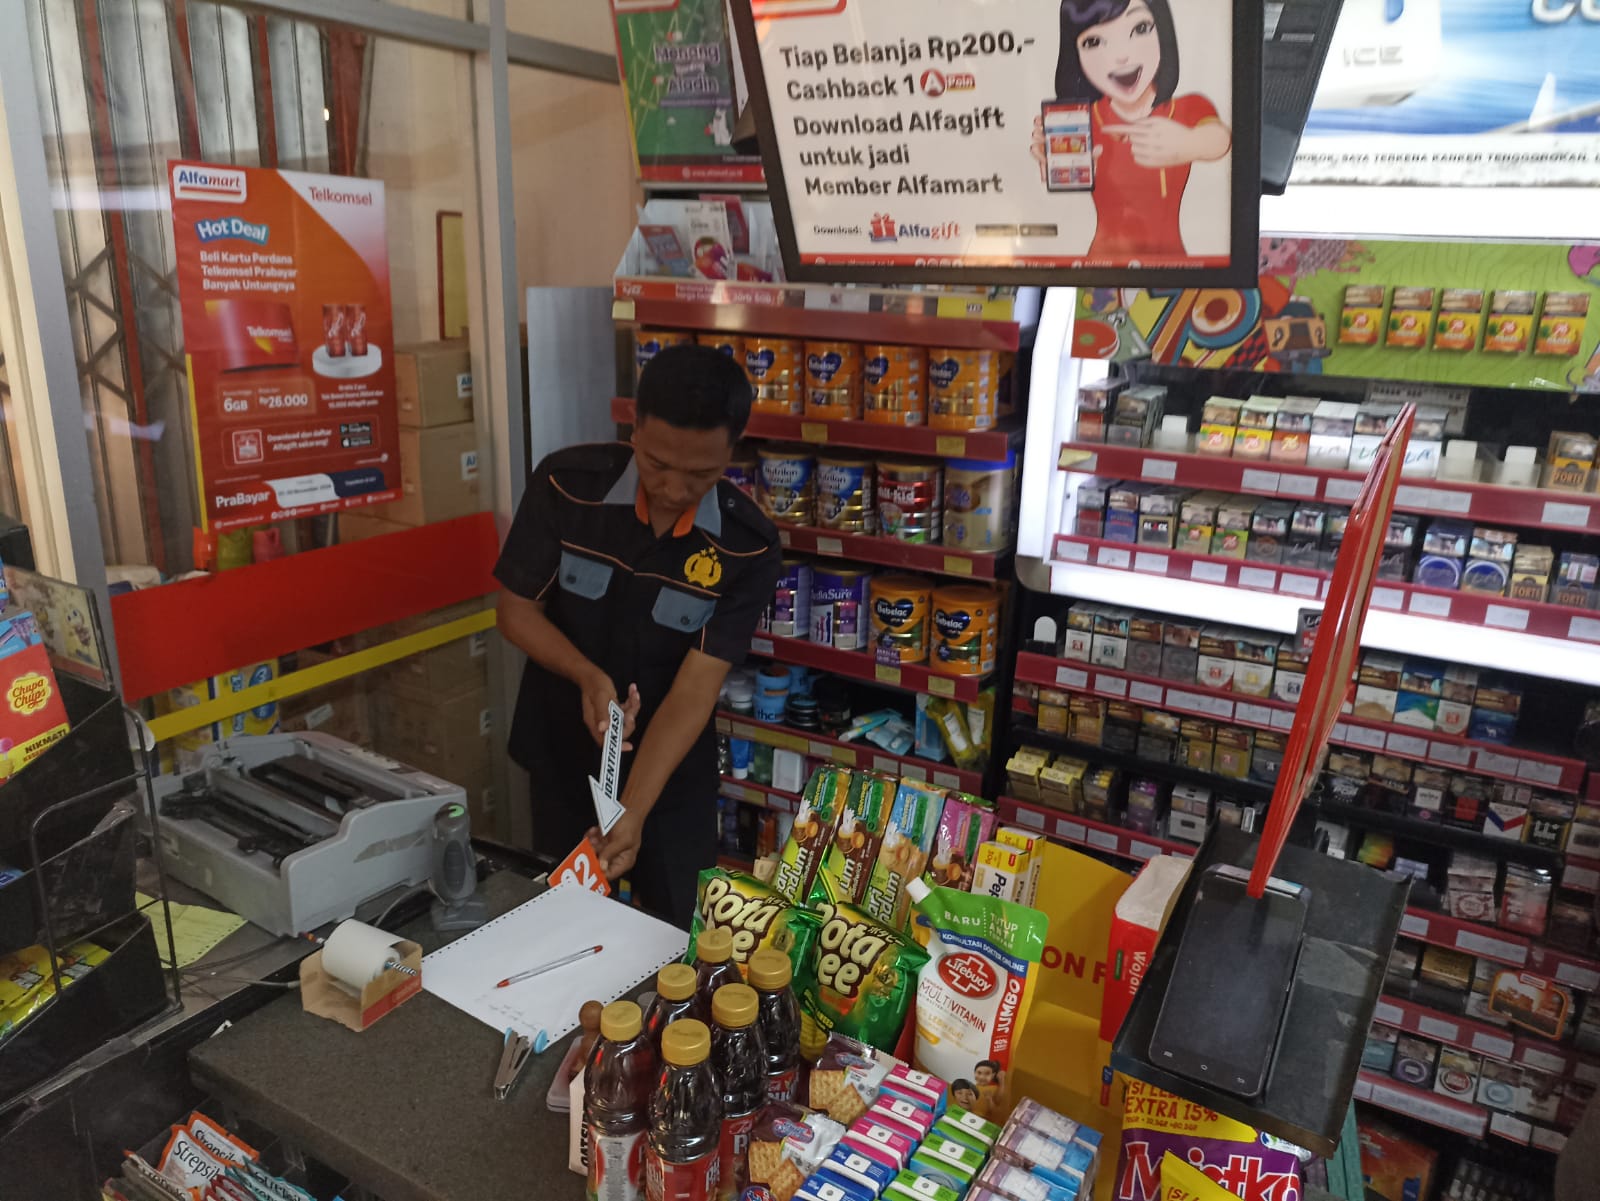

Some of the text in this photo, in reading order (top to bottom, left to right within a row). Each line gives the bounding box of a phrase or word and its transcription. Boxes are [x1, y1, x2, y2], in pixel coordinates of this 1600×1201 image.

[780, 30, 1035, 71] Tiap Belanja Rp200,-
[786, 75, 898, 100] Cashback
[903, 74, 915, 94] 1
[793, 107, 1005, 136] Download Alfagift
[799, 144, 910, 169] untuk jadi
[178, 169, 241, 189] Alfamart
[804, 173, 1004, 196] Member Alfamart
[309, 186, 373, 206] Telkomsel
[197, 219, 267, 241] Hot Deal
[813, 222, 961, 242] Download: Alfagift
[200, 251, 293, 264] Beli Kartu Perdana
[201, 265, 297, 278] Telkomsel Prabayar
[203, 279, 296, 292] Banyak Untungnya
[246, 326, 292, 338] Telkomsel
[223, 397, 248, 412] 6GB
[215, 491, 270, 508] PraBayar
[877, 604, 908, 617] Bebelac
[12, 679, 45, 699] Chupa
[14, 690, 46, 709] Chups
[604, 709, 621, 799] IDENTIFIKASI
[702, 878, 779, 934] Pota
[944, 910, 981, 926] BARU
[946, 957, 993, 992] Lifebuoy
[919, 981, 987, 1033] MULTIVITAMIN
[997, 979, 1021, 1034] JUMBO
[1125, 1096, 1219, 1122] EXTRA 15%
